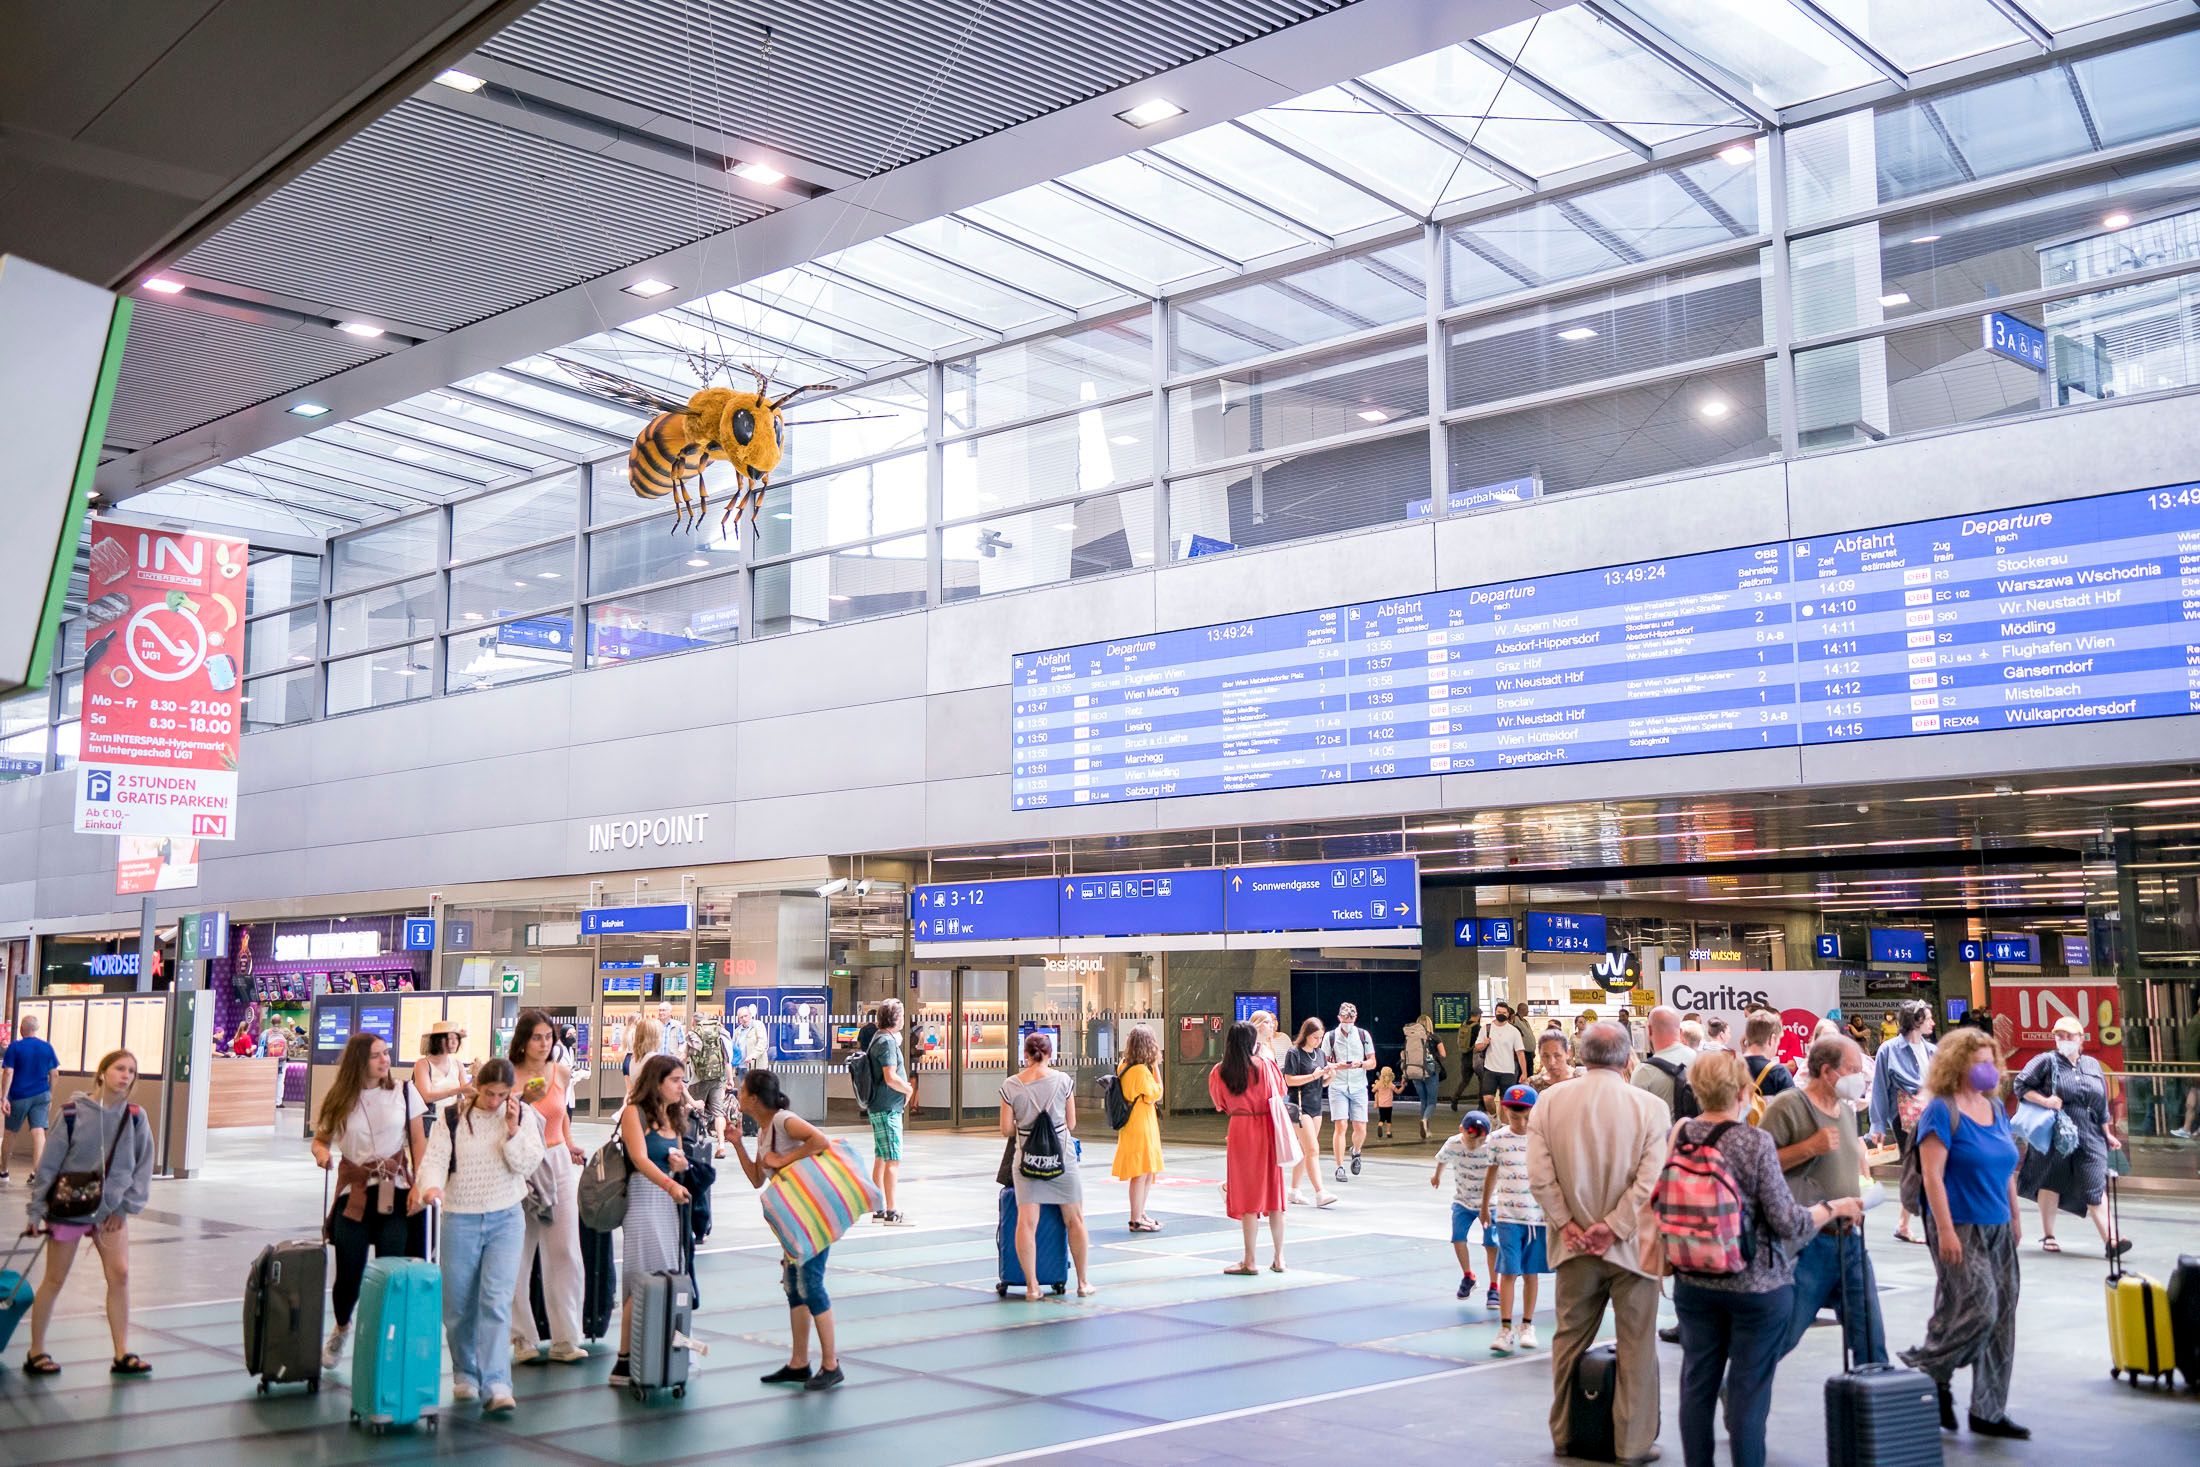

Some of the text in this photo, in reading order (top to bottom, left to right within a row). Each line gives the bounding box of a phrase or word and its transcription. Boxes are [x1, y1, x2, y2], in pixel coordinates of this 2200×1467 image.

[1996, 320, 2016, 351] 3 A
[1961, 512, 2053, 537] Departure
[1834, 532, 1896, 554] Abfahrt
[1995, 532, 2018, 542] nach
[138, 533, 204, 576] IN
[1933, 542, 1950, 552] Zug
[1997, 555, 2068, 573] Stockerau
[1604, 564, 1666, 586] 13:49:24
[1998, 564, 2162, 594] Warszawa Wschodnia
[1820, 580, 1855, 594] 14:09
[1470, 586, 1536, 605] Departure
[1754, 592, 1762, 602] 3
[1822, 590, 1970, 614] 14:10 EC 102
[2095, 590, 2122, 604] Hbf
[1377, 600, 1422, 618] Abfahrt
[1755, 611, 1764, 622] 2
[1552, 616, 1578, 628] Nord
[1822, 620, 1856, 635] 14:11
[2001, 620, 2056, 638] Mödling
[1208, 624, 1254, 642] 13:49:24
[1756, 631, 1765, 642] 8
[142, 640, 154, 650] im
[1106, 641, 1156, 658] Departure
[1495, 632, 1600, 655] Absdorf-Hippersdorf
[1823, 633, 1952, 656] 14:11 S2
[2002, 636, 2116, 658] Flughafen Wien
[142, 651, 161, 662] UG1
[1036, 652, 1071, 668] Abfahrt
[1367, 652, 1460, 670] 13:57 S4
[1758, 651, 1764, 662] 1
[1320, 666, 1325, 676] 1
[1759, 671, 1767, 682] 2
[1824, 662, 1860, 676] 14:12
[2004, 658, 2093, 680] Gänserndorf
[1564, 671, 1584, 684] Hbf
[1124, 686, 1179, 700] Wien Meidling
[1825, 676, 1954, 696] 14:12 S1
[2005, 682, 2081, 702] Mistelbach
[1368, 686, 1472, 705] 13:59 REX1
[1760, 690, 1766, 702] 1
[91, 694, 232, 718] Mo Fr 8.30 21.00
[1028, 702, 1048, 713] 13:47
[1320, 700, 1325, 711] 1
[1826, 696, 1956, 717] 14:15 S2
[2005, 700, 2137, 722] Wulkaprodersdorf
[1566, 708, 1586, 721] Hbf
[1760, 711, 1769, 723] 3
[90, 713, 232, 735] Sa 8.30 18.00
[1124, 721, 1152, 734] Liesing
[1826, 723, 1863, 738] 14:15
[1028, 733, 1048, 744] 13:50
[1368, 724, 1462, 740] 14:02 S3
[1762, 731, 1768, 742] 1
[90, 732, 226, 753] Zum INTERSPAR-Hypermarkt
[1315, 735, 1326, 746] 12
[103, 746, 172, 760] Untergeschoß
[174, 750, 193, 761] UG1
[1124, 752, 1164, 766] Marchegg
[1498, 748, 1568, 766] Payerbach-R.
[1028, 764, 1048, 775] 13:51
[1321, 768, 1327, 780] 7
[1369, 760, 1475, 776] 14:08 REX3
[118, 775, 196, 791] 2 STUNDEN
[1125, 784, 1159, 798] Salzburg
[1160, 782, 1176, 794] Hbf
[117, 791, 228, 810] GRATIS PARKEN!
[1028, 794, 1048, 806] 13:55
[86, 808, 100, 818] Ab
[102, 808, 110, 819] €
[85, 819, 122, 832] Einkauf
[194, 816, 226, 836] IN
[588, 812, 710, 853] INFOPOINT
[1252, 880, 1320, 894] Sonnwendgasse
[1332, 910, 1363, 920] Tickets
[602, 920, 624, 928] InfoPoint
[962, 924, 974, 934] WC
[1460, 924, 1472, 942] 4
[1822, 938, 1832, 954] 5
[1965, 944, 1975, 958] 6
[1672, 984, 1770, 1011] Caritas
[2018, 990, 2090, 1029] IN
[1781, 1021, 1809, 1036] nfo
